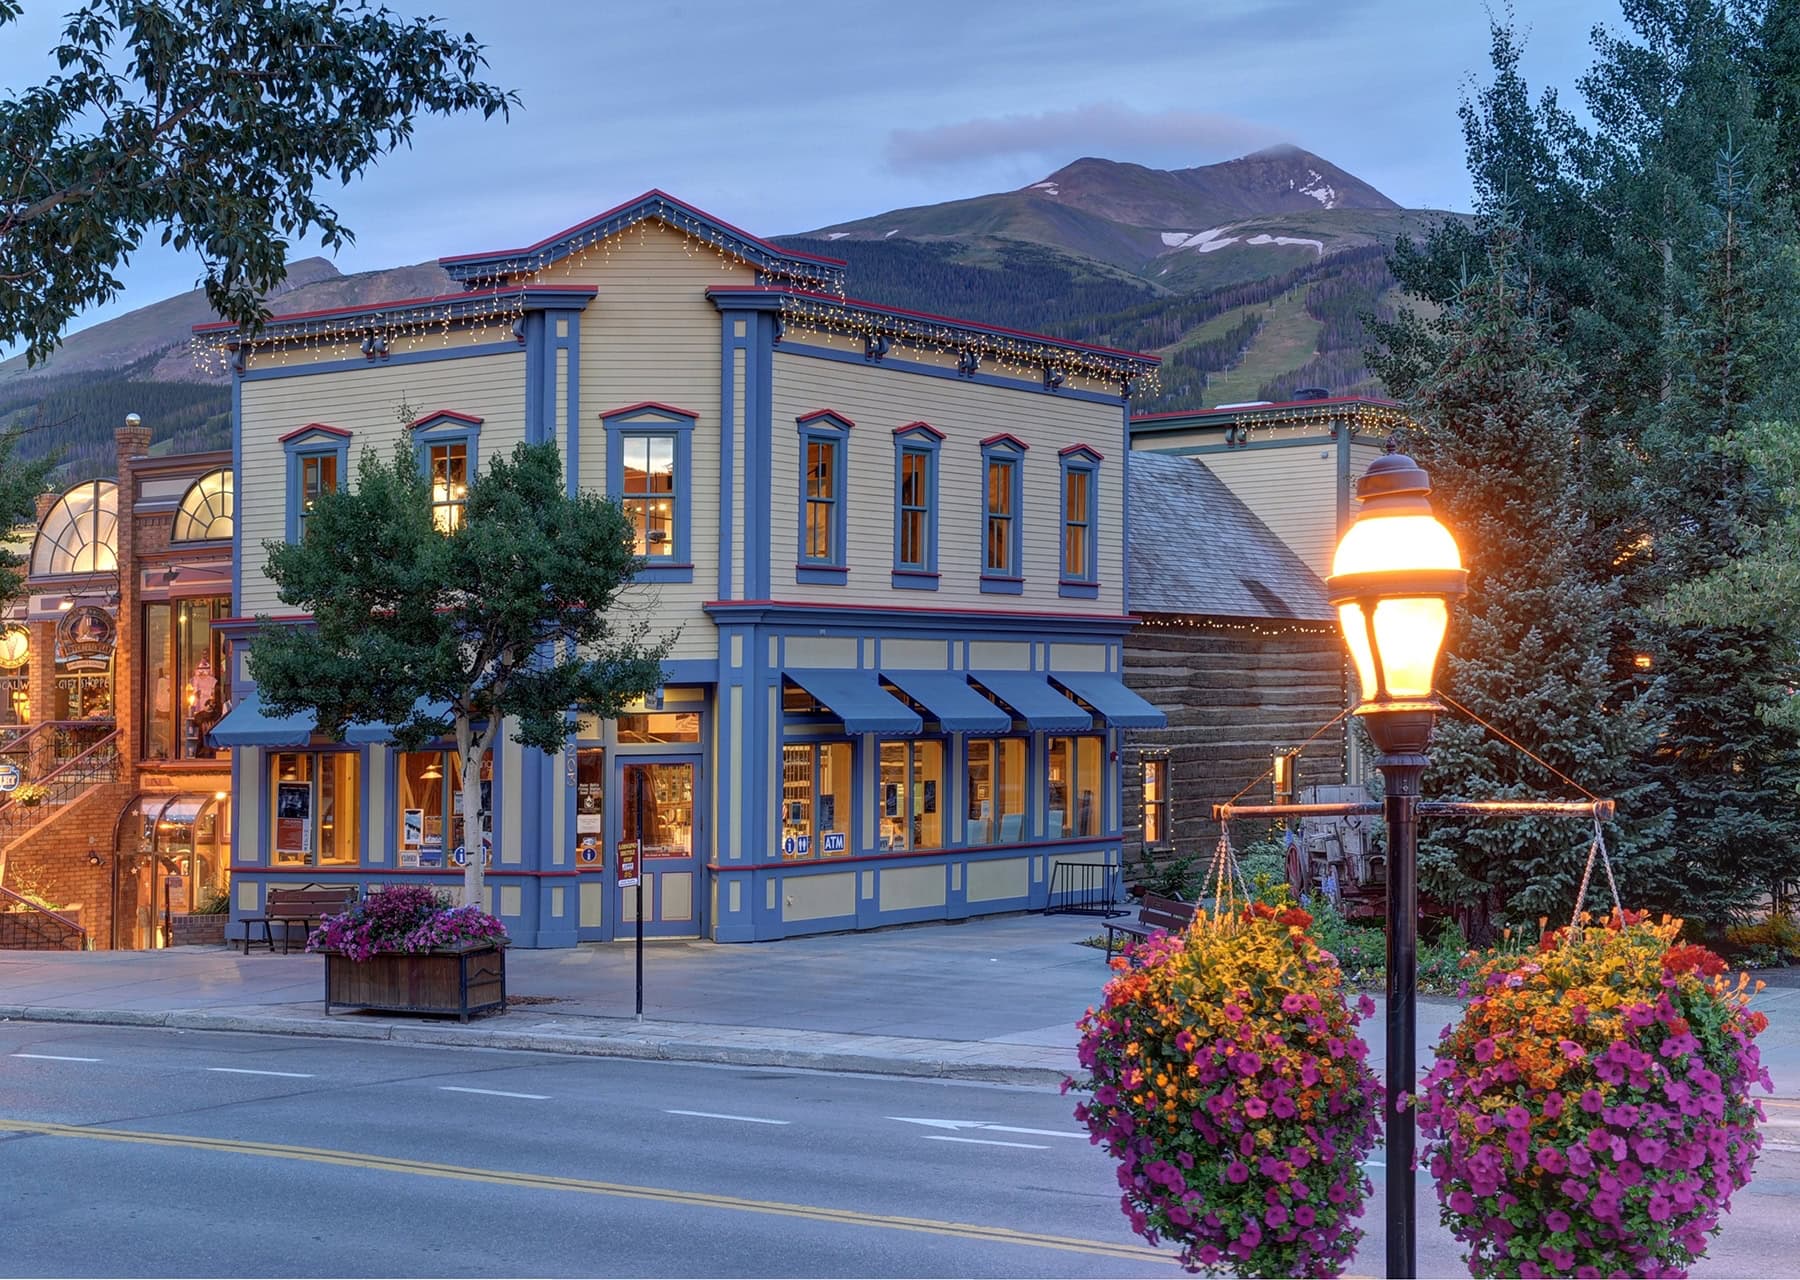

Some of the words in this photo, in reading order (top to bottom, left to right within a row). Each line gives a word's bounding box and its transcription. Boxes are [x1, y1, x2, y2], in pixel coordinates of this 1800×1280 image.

[58, 679, 77, 689] GIFT
[79, 677, 110, 689] SHOPPE
[825, 836, 843, 849] ATM
